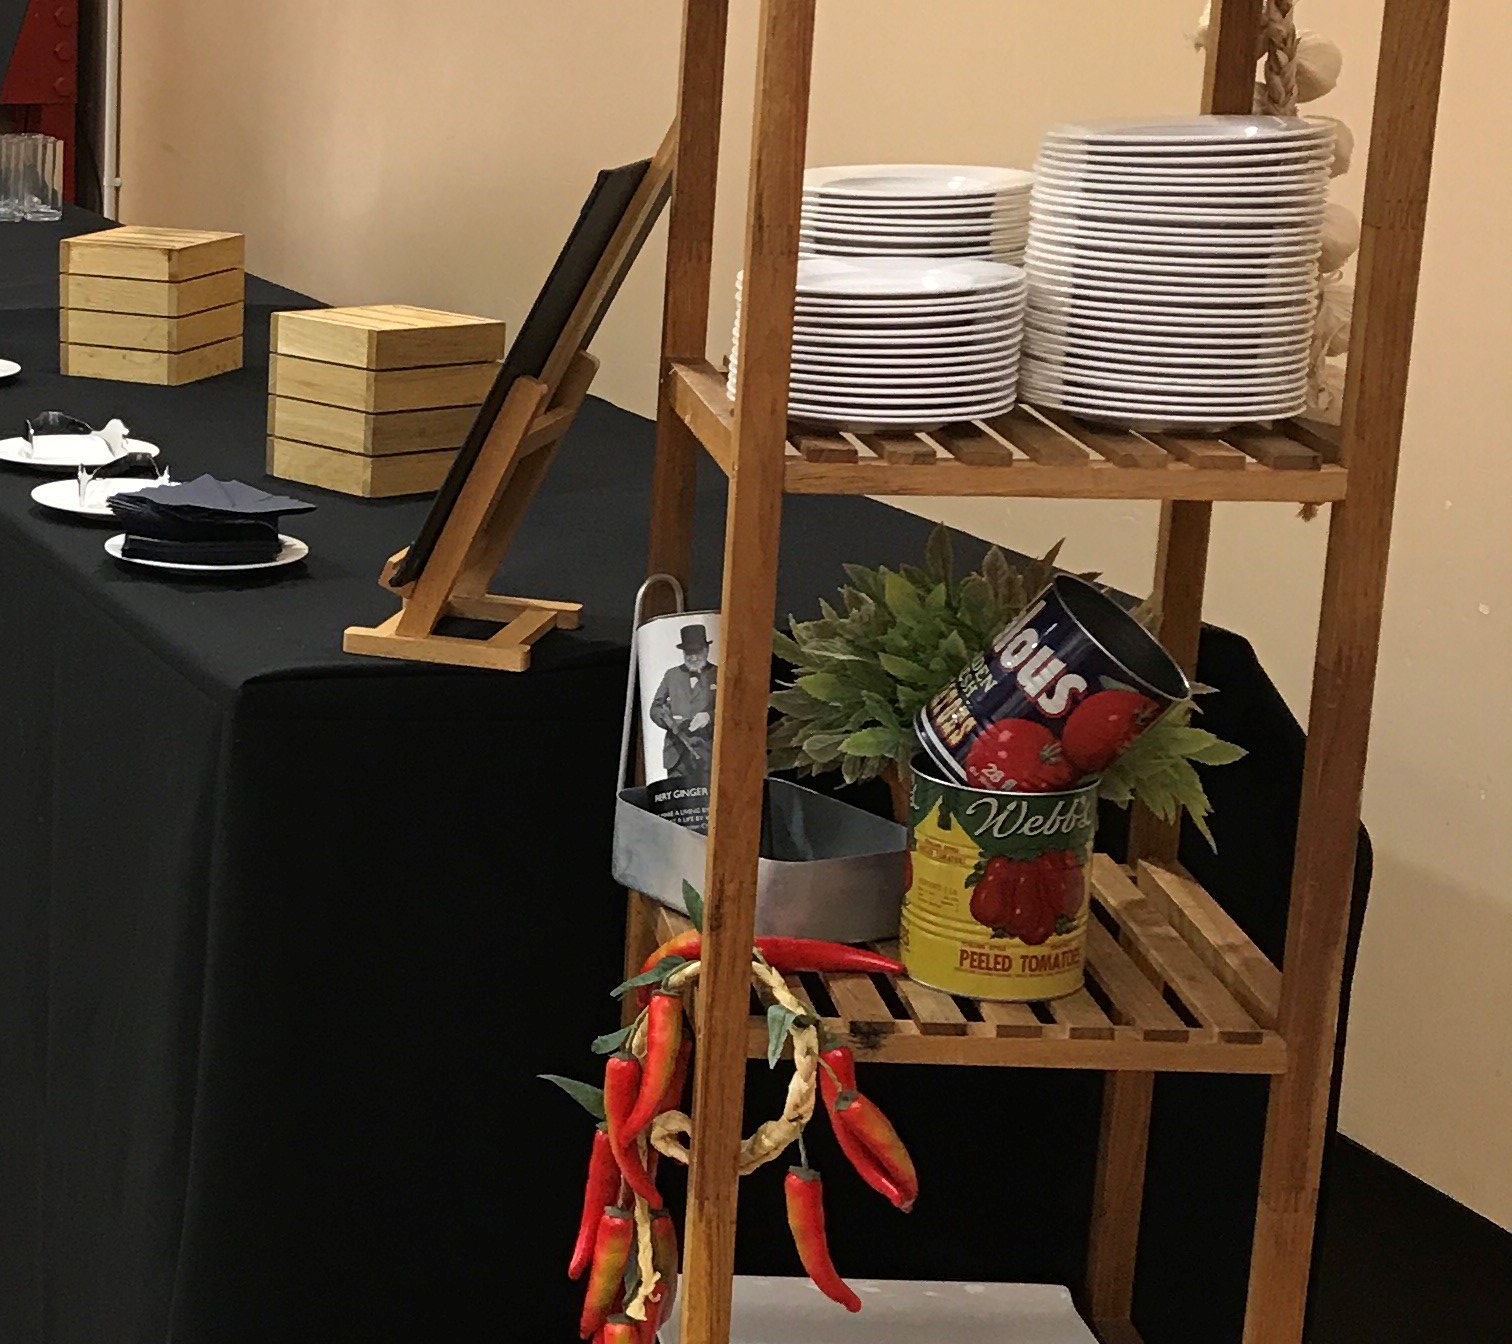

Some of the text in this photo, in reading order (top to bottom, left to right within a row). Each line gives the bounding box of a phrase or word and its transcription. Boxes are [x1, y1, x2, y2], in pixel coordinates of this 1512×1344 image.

[994, 600, 1089, 716] lous
[673, 786, 709, 799] GINGER
[965, 795, 1092, 838] Webb's
[959, 948, 1013, 973] PEELED
